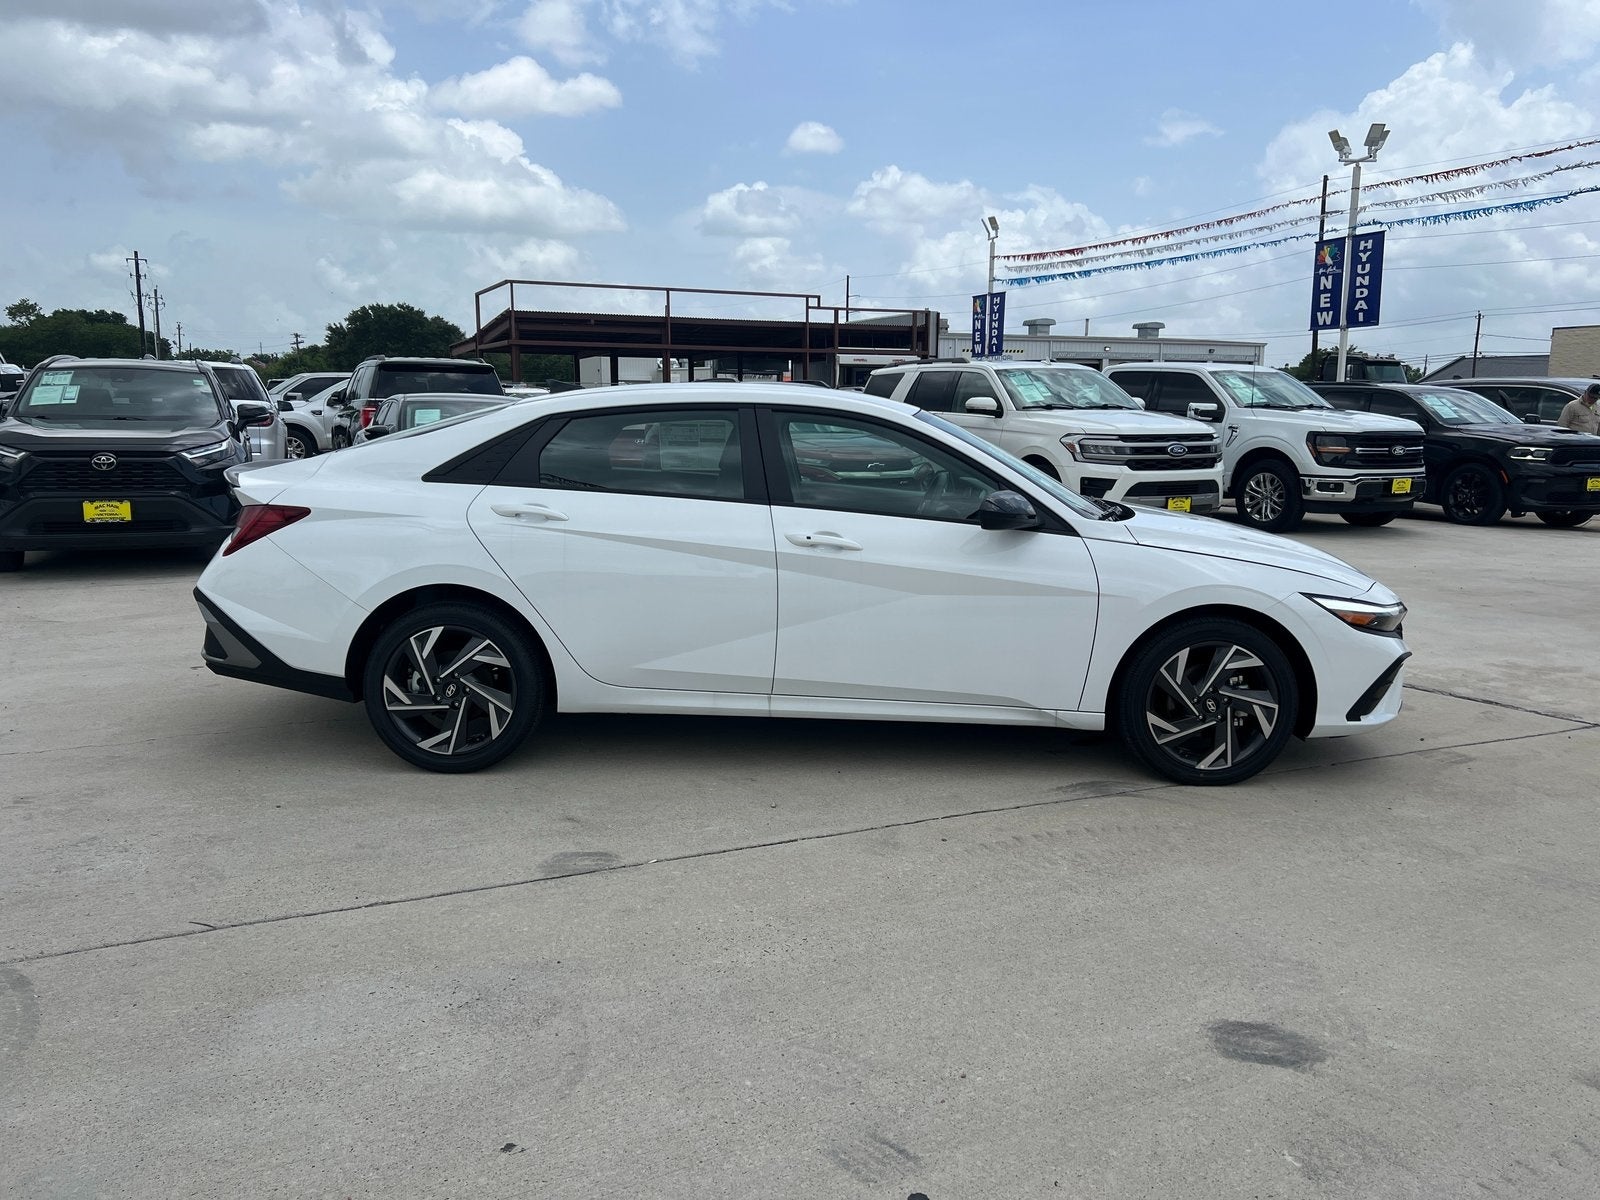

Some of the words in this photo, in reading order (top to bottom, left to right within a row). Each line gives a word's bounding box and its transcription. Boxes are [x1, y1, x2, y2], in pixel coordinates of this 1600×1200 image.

[1316, 275, 1334, 326] NEW
[1354, 239, 1373, 322] HYUNDAI
[974, 319, 982, 354] NEW
[991, 296, 1000, 352] HYUNDAI
